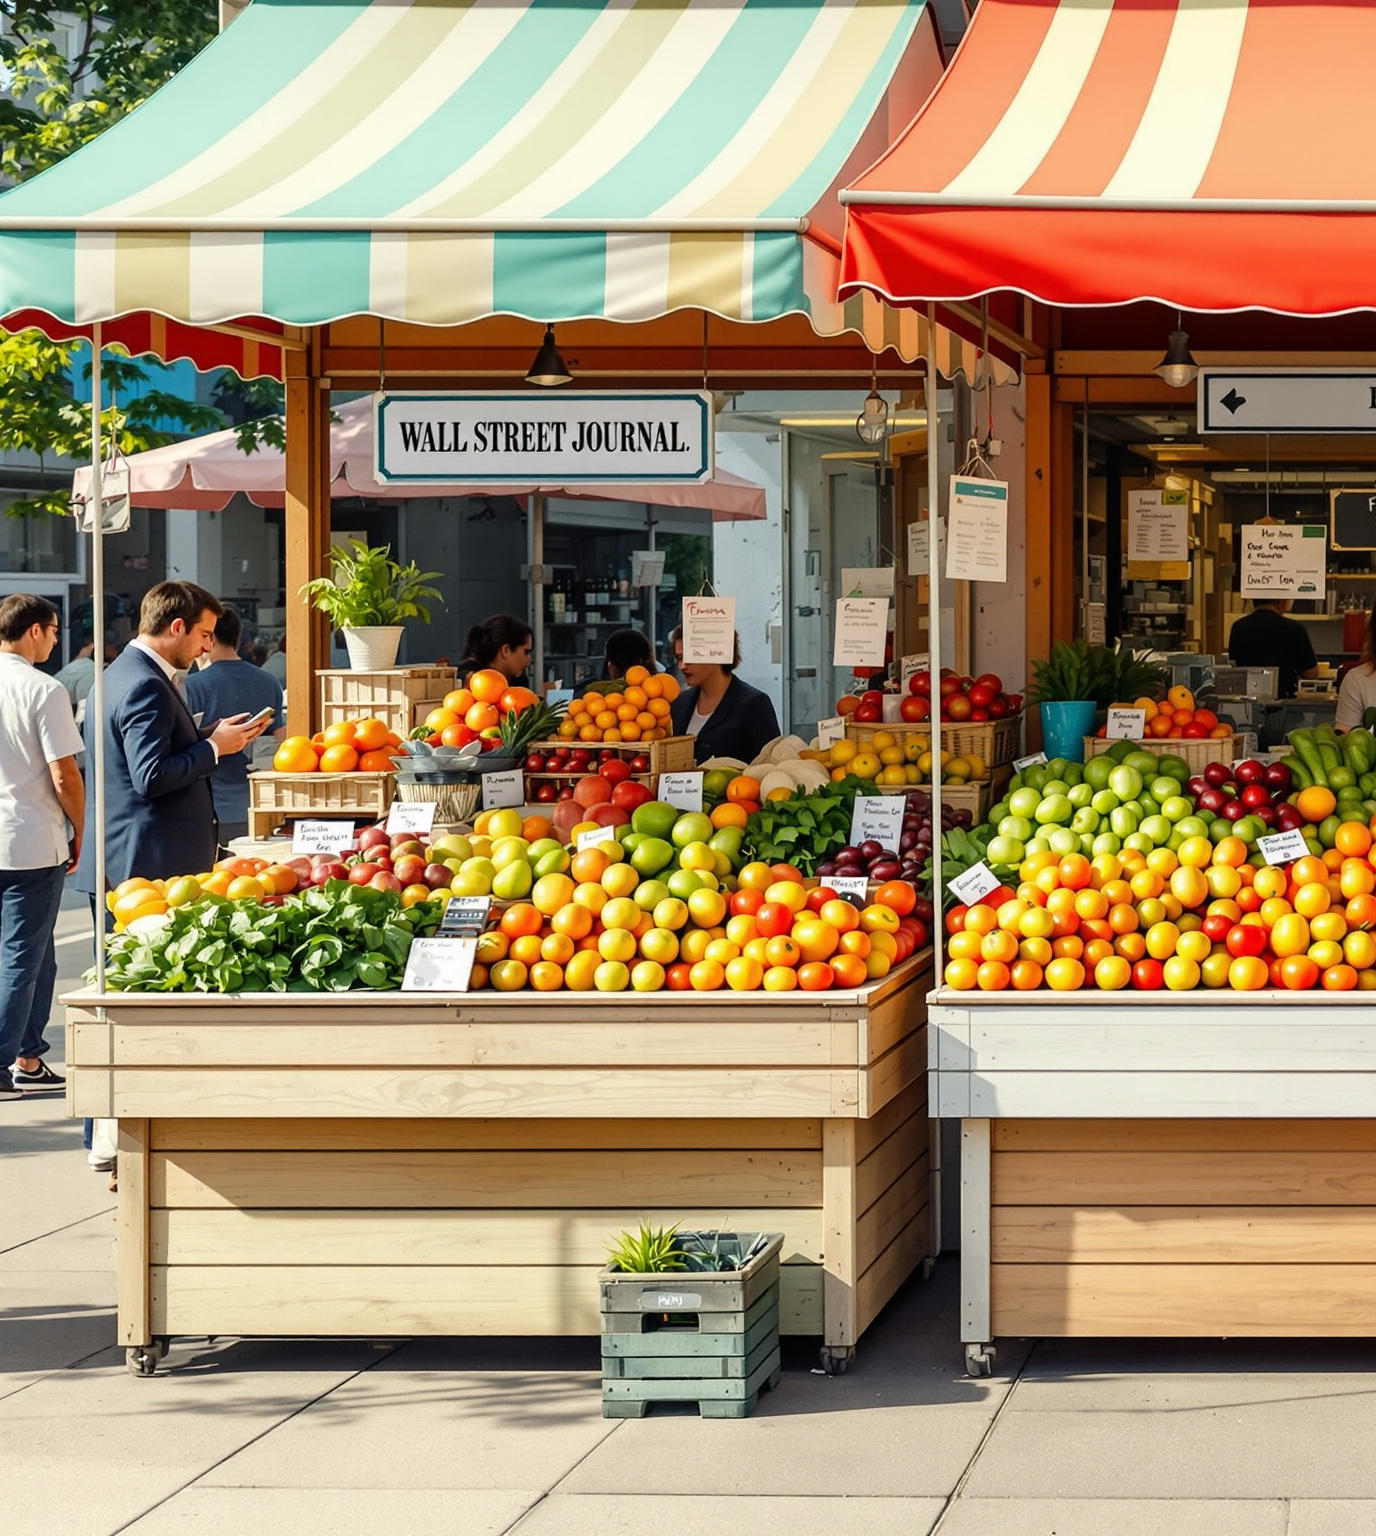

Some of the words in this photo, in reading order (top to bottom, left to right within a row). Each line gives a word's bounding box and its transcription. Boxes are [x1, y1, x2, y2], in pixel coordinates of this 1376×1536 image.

[399, 421, 467, 452] WALL
[473, 421, 566, 453] STREET
[571, 421, 690, 453] JOURNAL.
